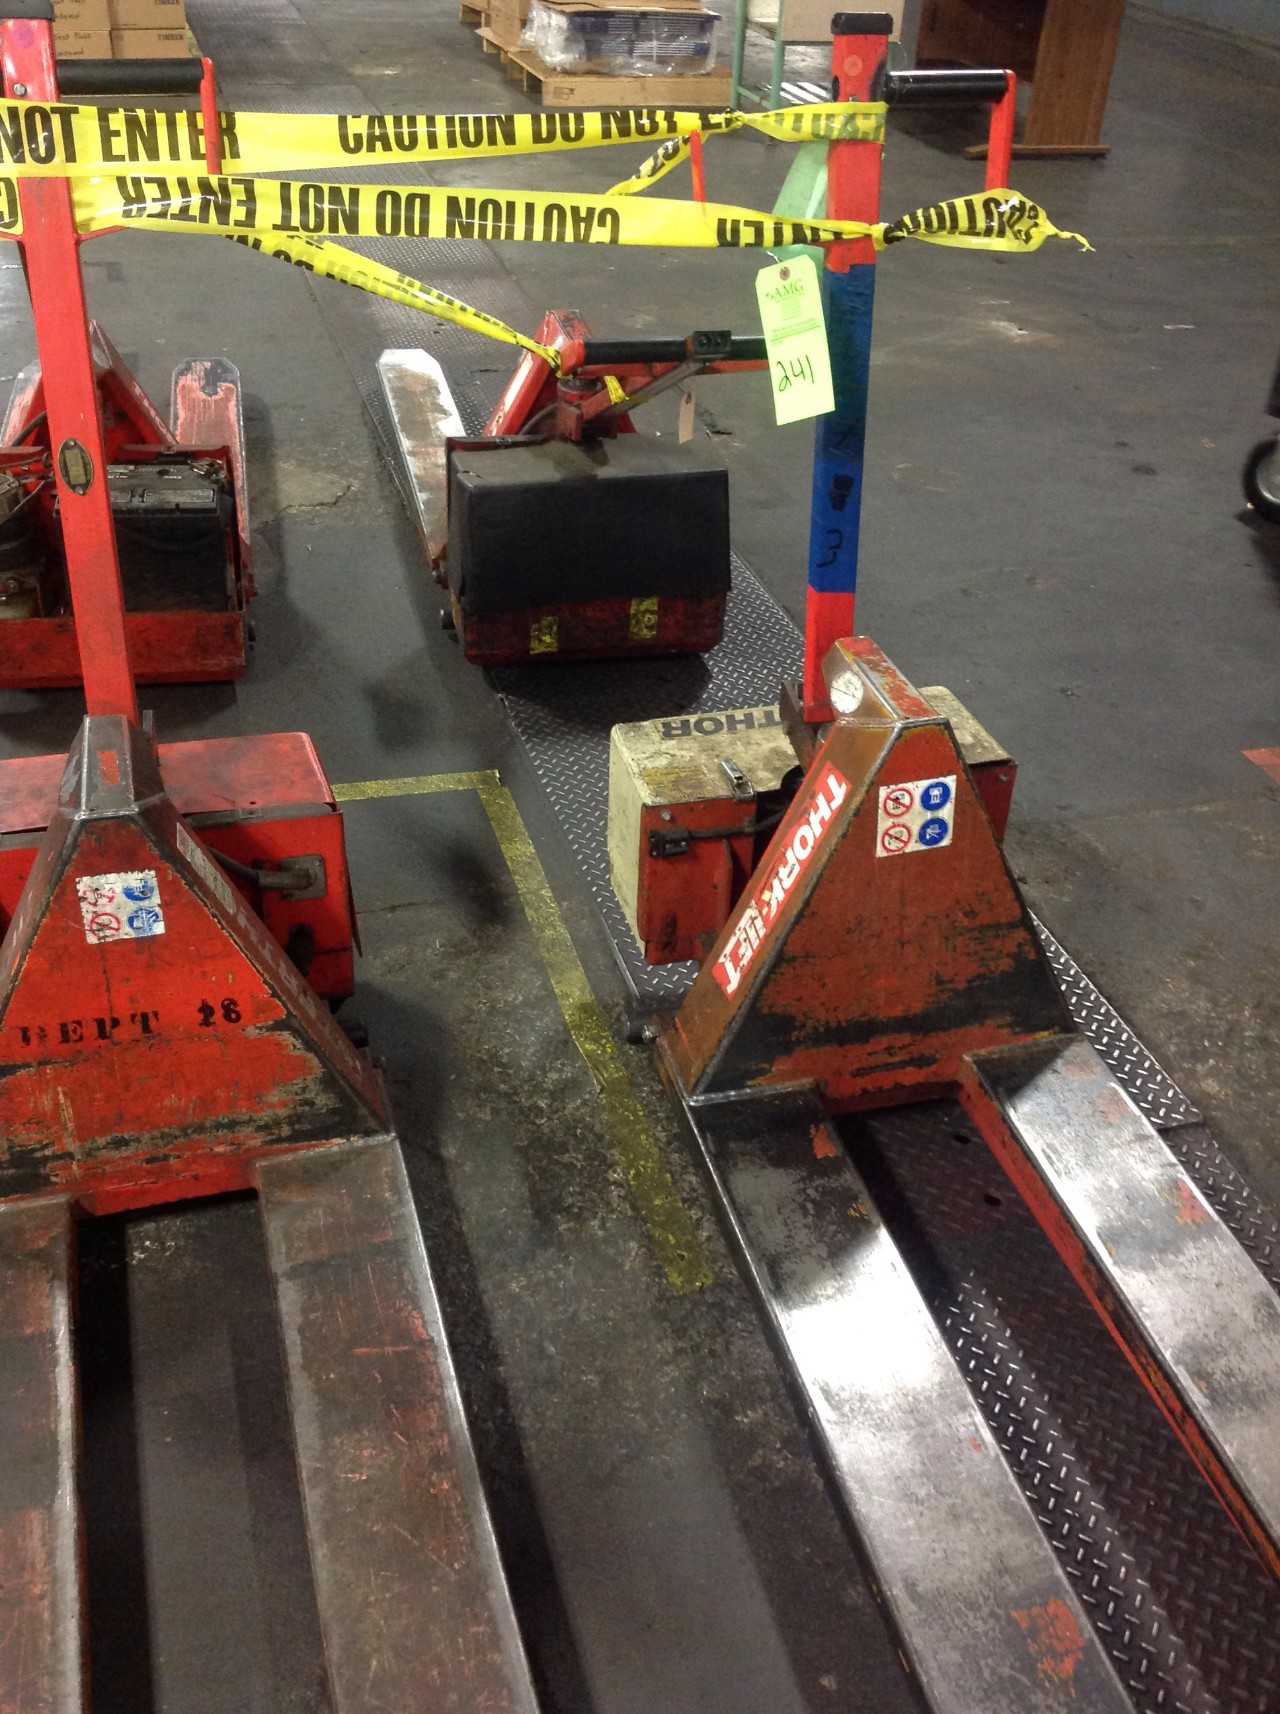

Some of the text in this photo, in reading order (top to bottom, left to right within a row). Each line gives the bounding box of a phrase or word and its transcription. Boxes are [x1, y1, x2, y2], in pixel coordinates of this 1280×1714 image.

[0, 106, 241, 165] NOT ENTER
[337, 115, 517, 155] CAUTION
[531, 112, 585, 145] DO
[601, 108, 678, 140] NOT
[115, 175, 621, 245] CAUTION DO NOT ENTER
[776, 354, 815, 392] 241
[661, 709, 783, 738] THOR
